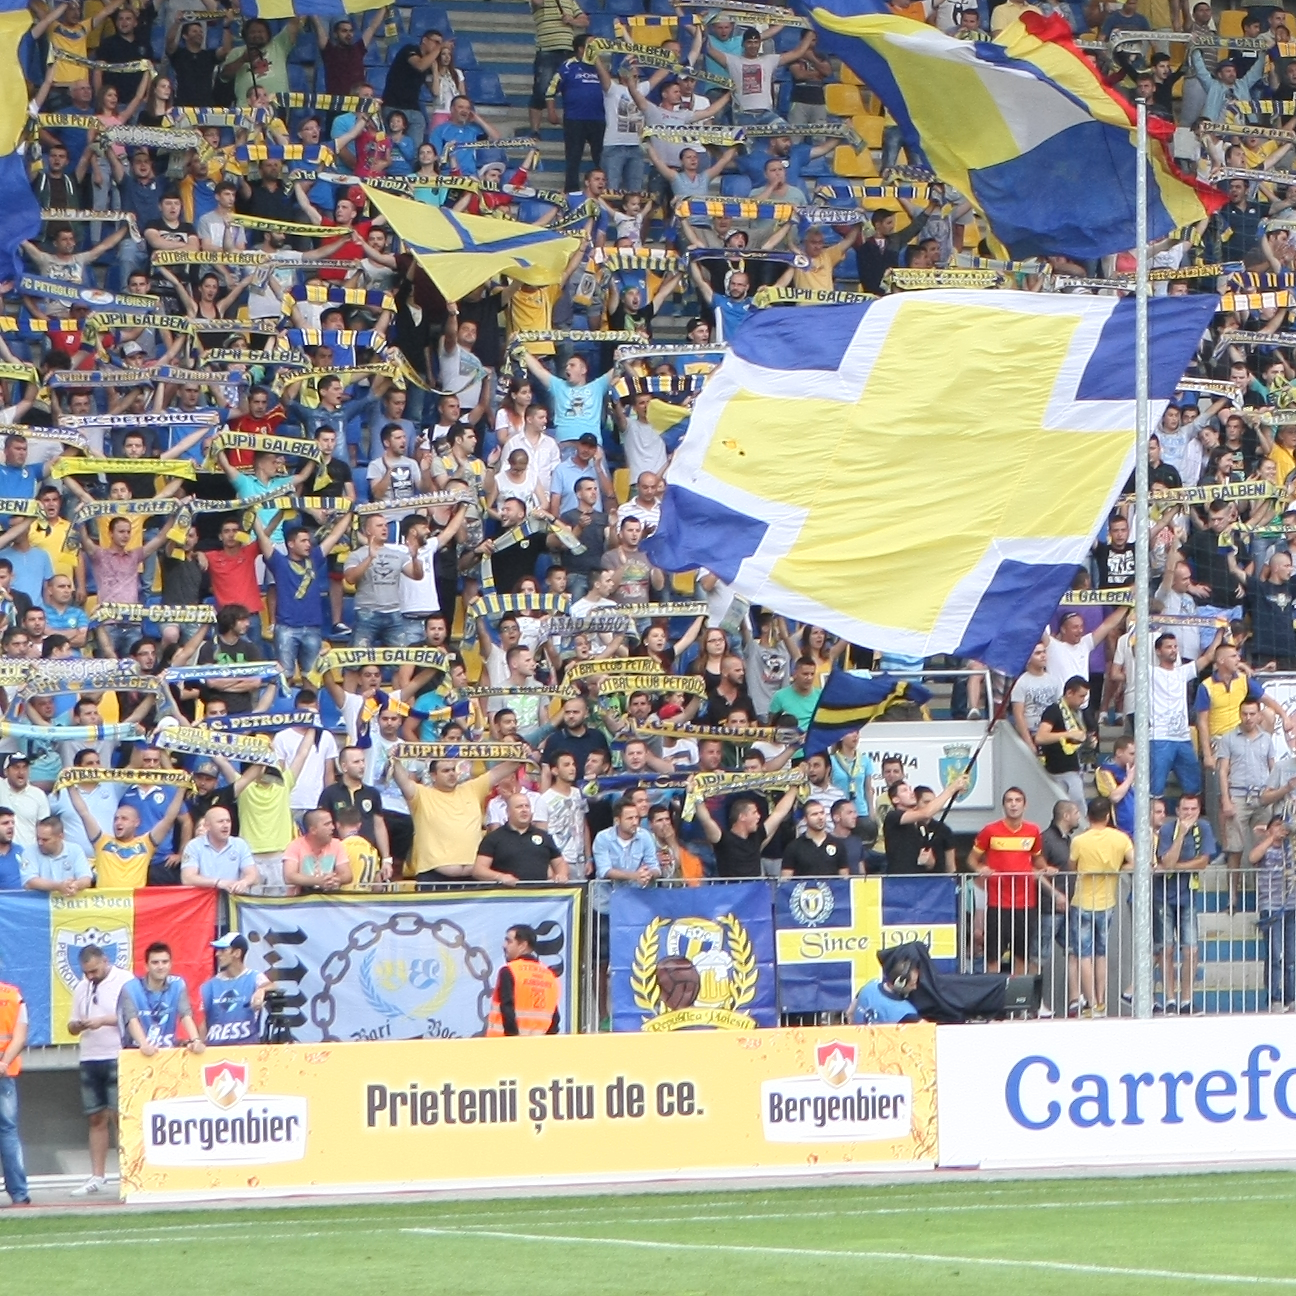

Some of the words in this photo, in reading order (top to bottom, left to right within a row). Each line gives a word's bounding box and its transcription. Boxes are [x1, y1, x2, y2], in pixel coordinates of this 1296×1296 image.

[779, 286, 813, 300] LUPII
[101, 314, 135, 327] LUPII
[225, 437, 258, 452] LUPII
[262, 439, 320, 459] GALBENI
[1211, 482, 1268, 501] GALBENI
[335, 648, 378, 665] LUPII
[635, 675, 661, 692] CLUB
[230, 710, 320, 729] PETROLUL
[400, 743, 445, 760] LUPII
[799, 931, 869, 959] Since
[366, 1080, 518, 1128] Prietenii
[528, 1078, 596, 1135] știu
[605, 1076, 645, 1120] de
[656, 1081, 705, 1116] ce.
[768, 1086, 906, 1128] Bergenbier
[151, 1107, 300, 1151] Bergenbier
